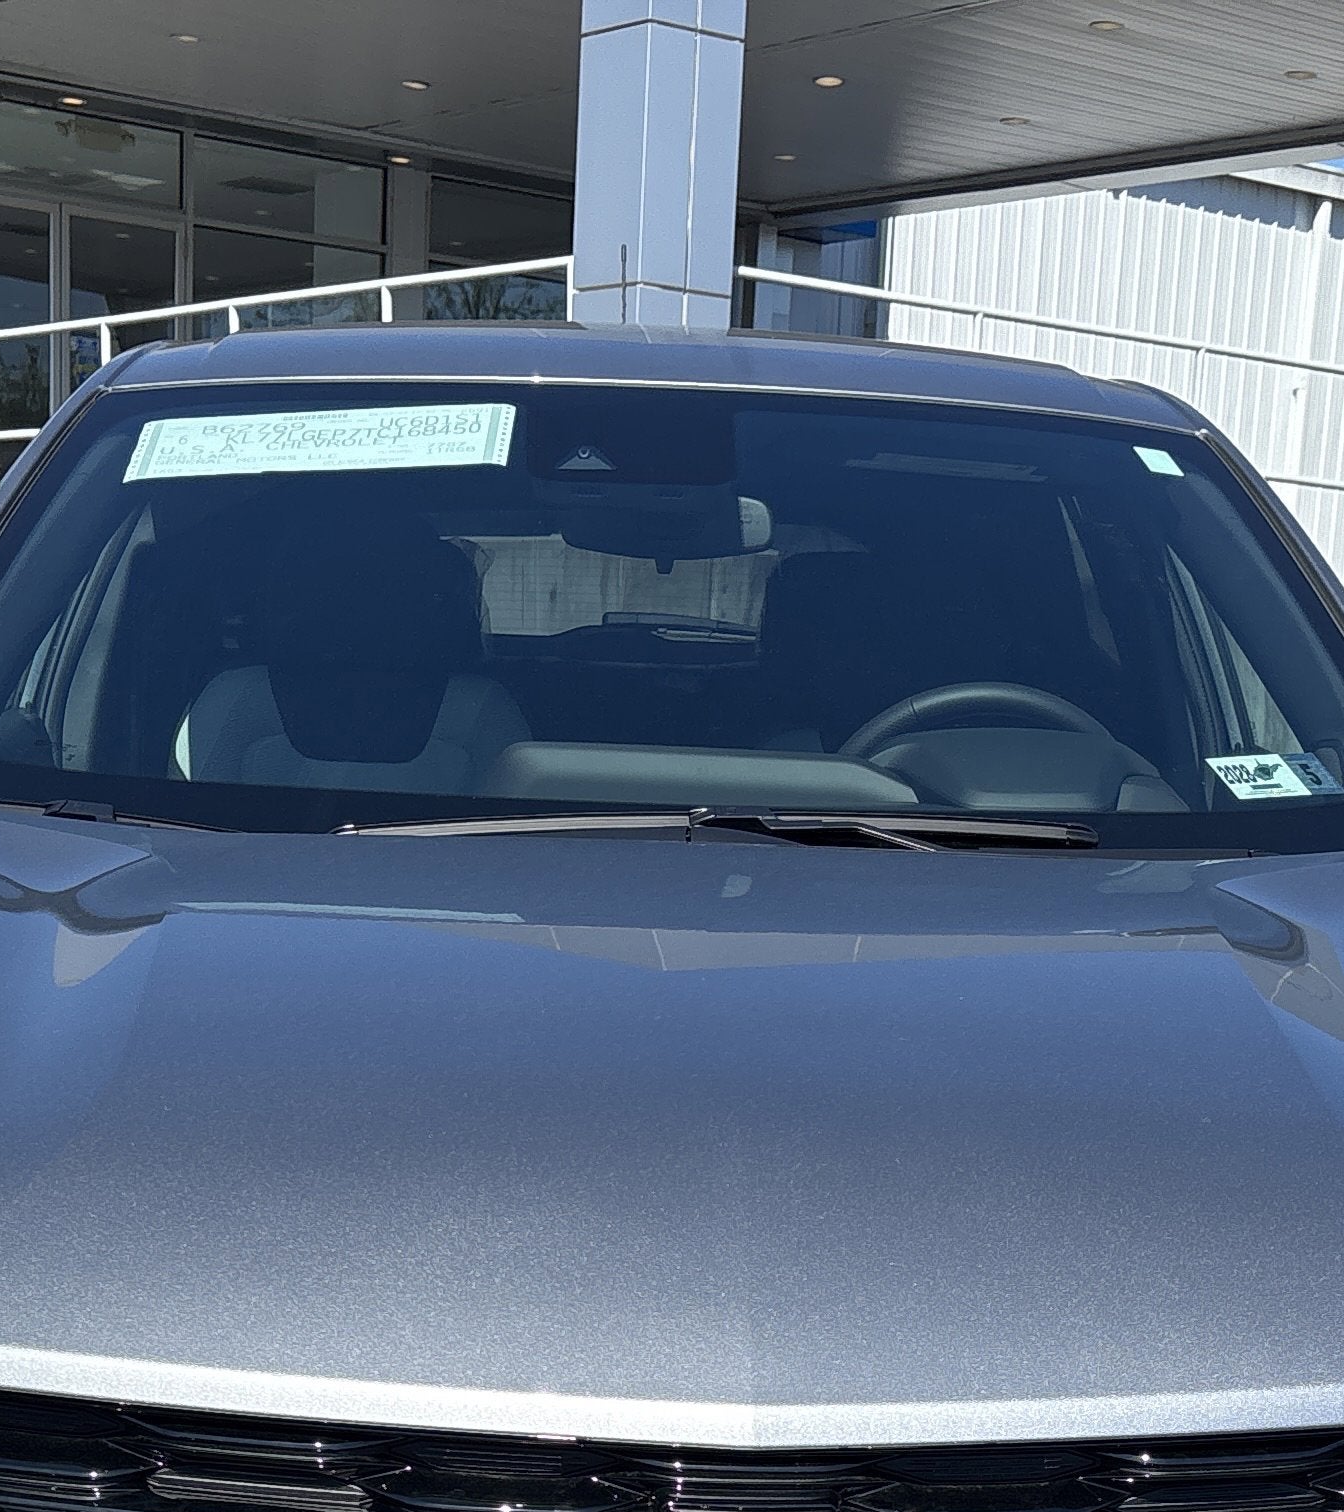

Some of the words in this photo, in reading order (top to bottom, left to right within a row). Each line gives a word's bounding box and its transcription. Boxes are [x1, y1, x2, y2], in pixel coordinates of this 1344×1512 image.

[202, 422, 306, 437] B62769
[178, 435, 188, 446] 6
[266, 436, 398, 450] CHEVROLET
[155, 458, 221, 466] GENERAL
[236, 455, 297, 464] MOTORS
[307, 453, 338, 461] LLC
[1216, 764, 1258, 784] 2028
[1297, 763, 1323, 786] 5
